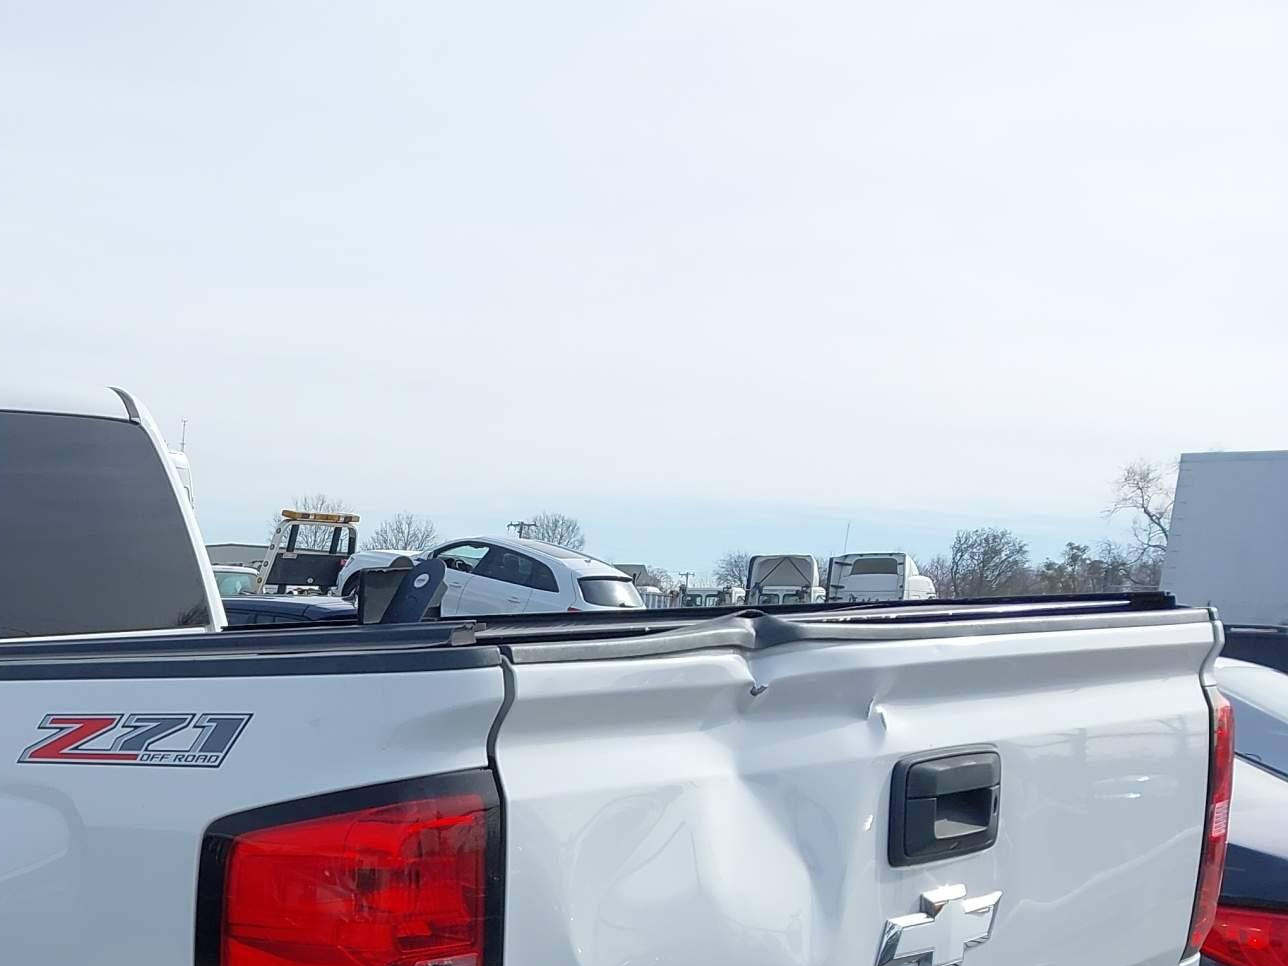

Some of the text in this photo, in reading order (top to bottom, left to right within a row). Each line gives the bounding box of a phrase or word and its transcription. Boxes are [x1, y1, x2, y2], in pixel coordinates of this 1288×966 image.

[17, 713, 254, 768] Z71
[140, 753, 220, 764] OFF ROAD
